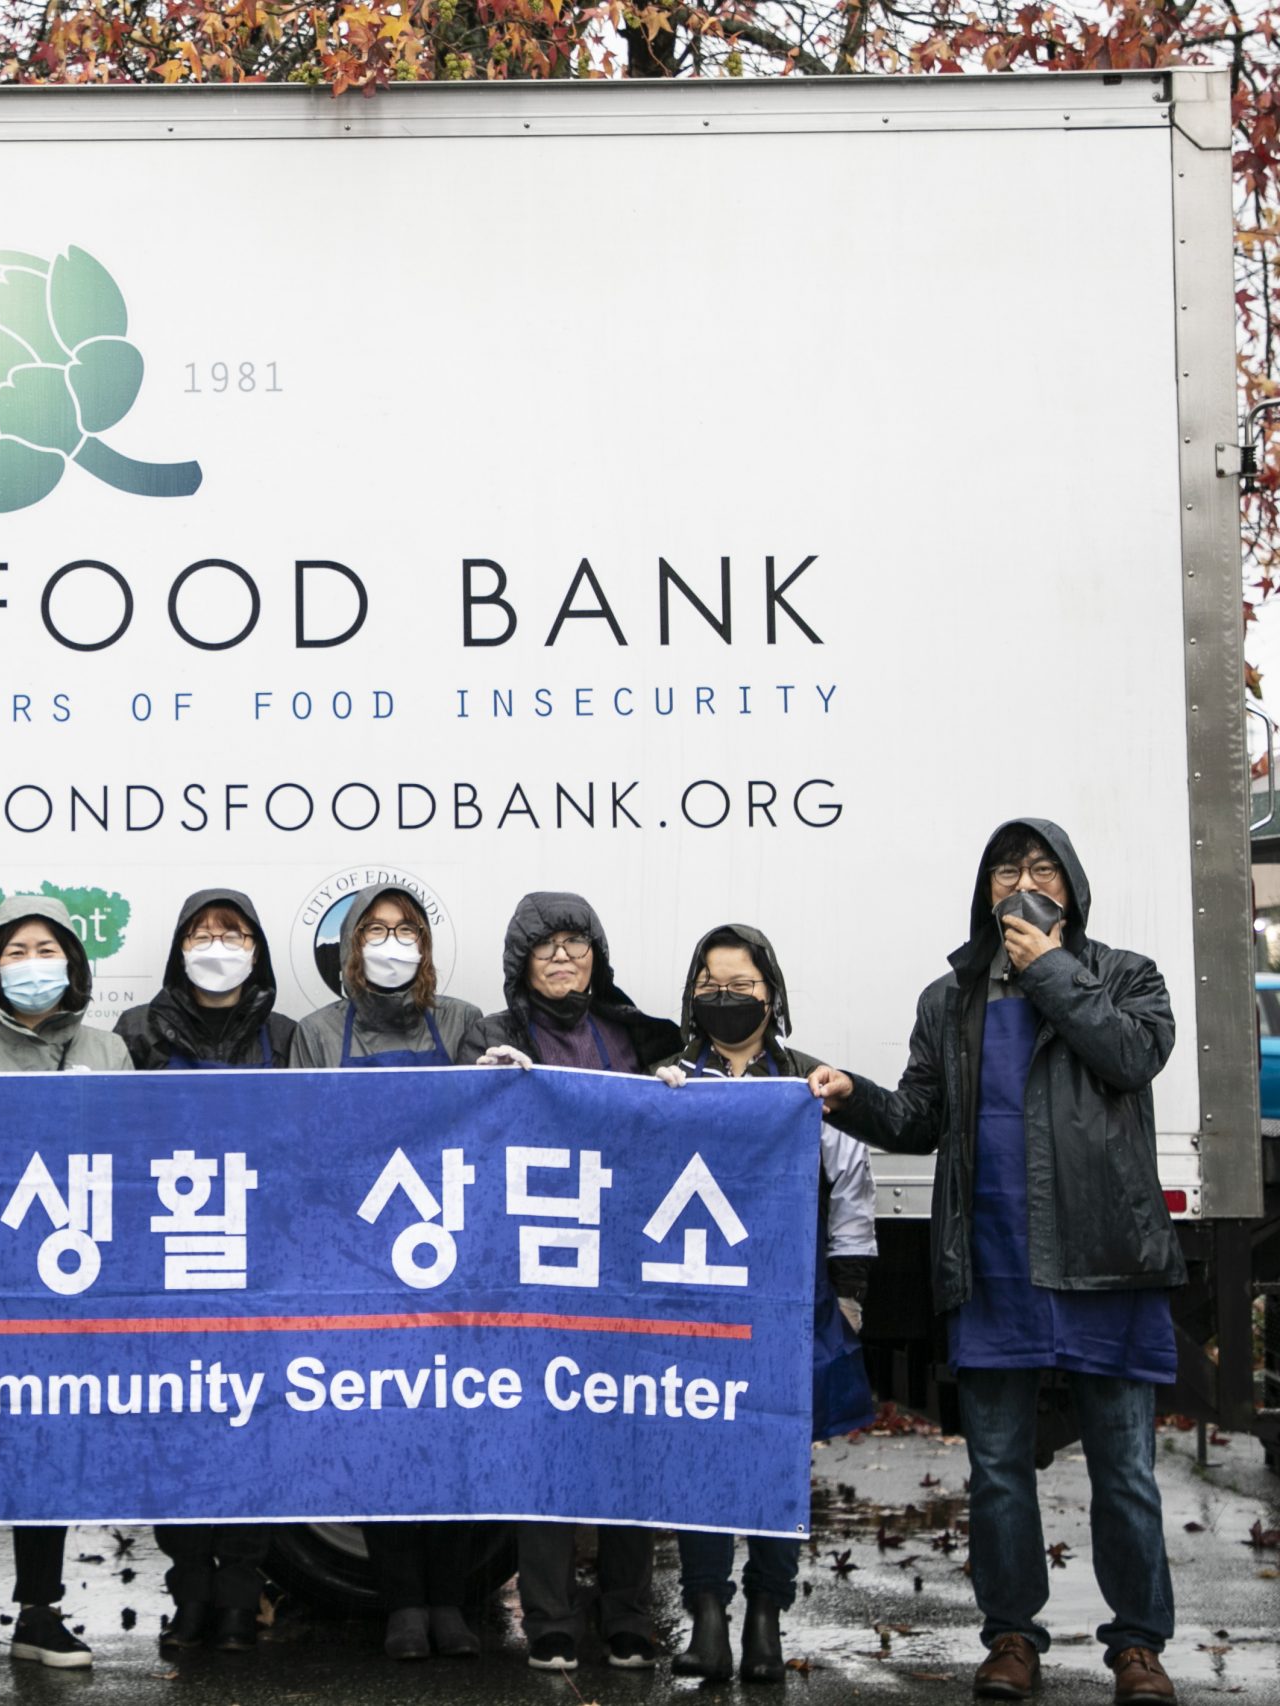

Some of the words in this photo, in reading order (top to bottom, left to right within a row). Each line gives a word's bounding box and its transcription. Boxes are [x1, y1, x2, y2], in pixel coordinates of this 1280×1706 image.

[183, 362, 285, 394] 1981
[463, 555, 826, 649] BANK
[132, 693, 194, 723] OF
[255, 691, 395, 722] FOOD
[457, 685, 838, 719] INSECURITY
[302, 886, 335, 926] CITY
[336, 872, 359, 892] OF
[1, 1150, 259, 1297] 생활
[357, 1146, 750, 1291] 상담소
[285, 1354, 524, 1413] Service
[544, 1356, 750, 1422] Center
